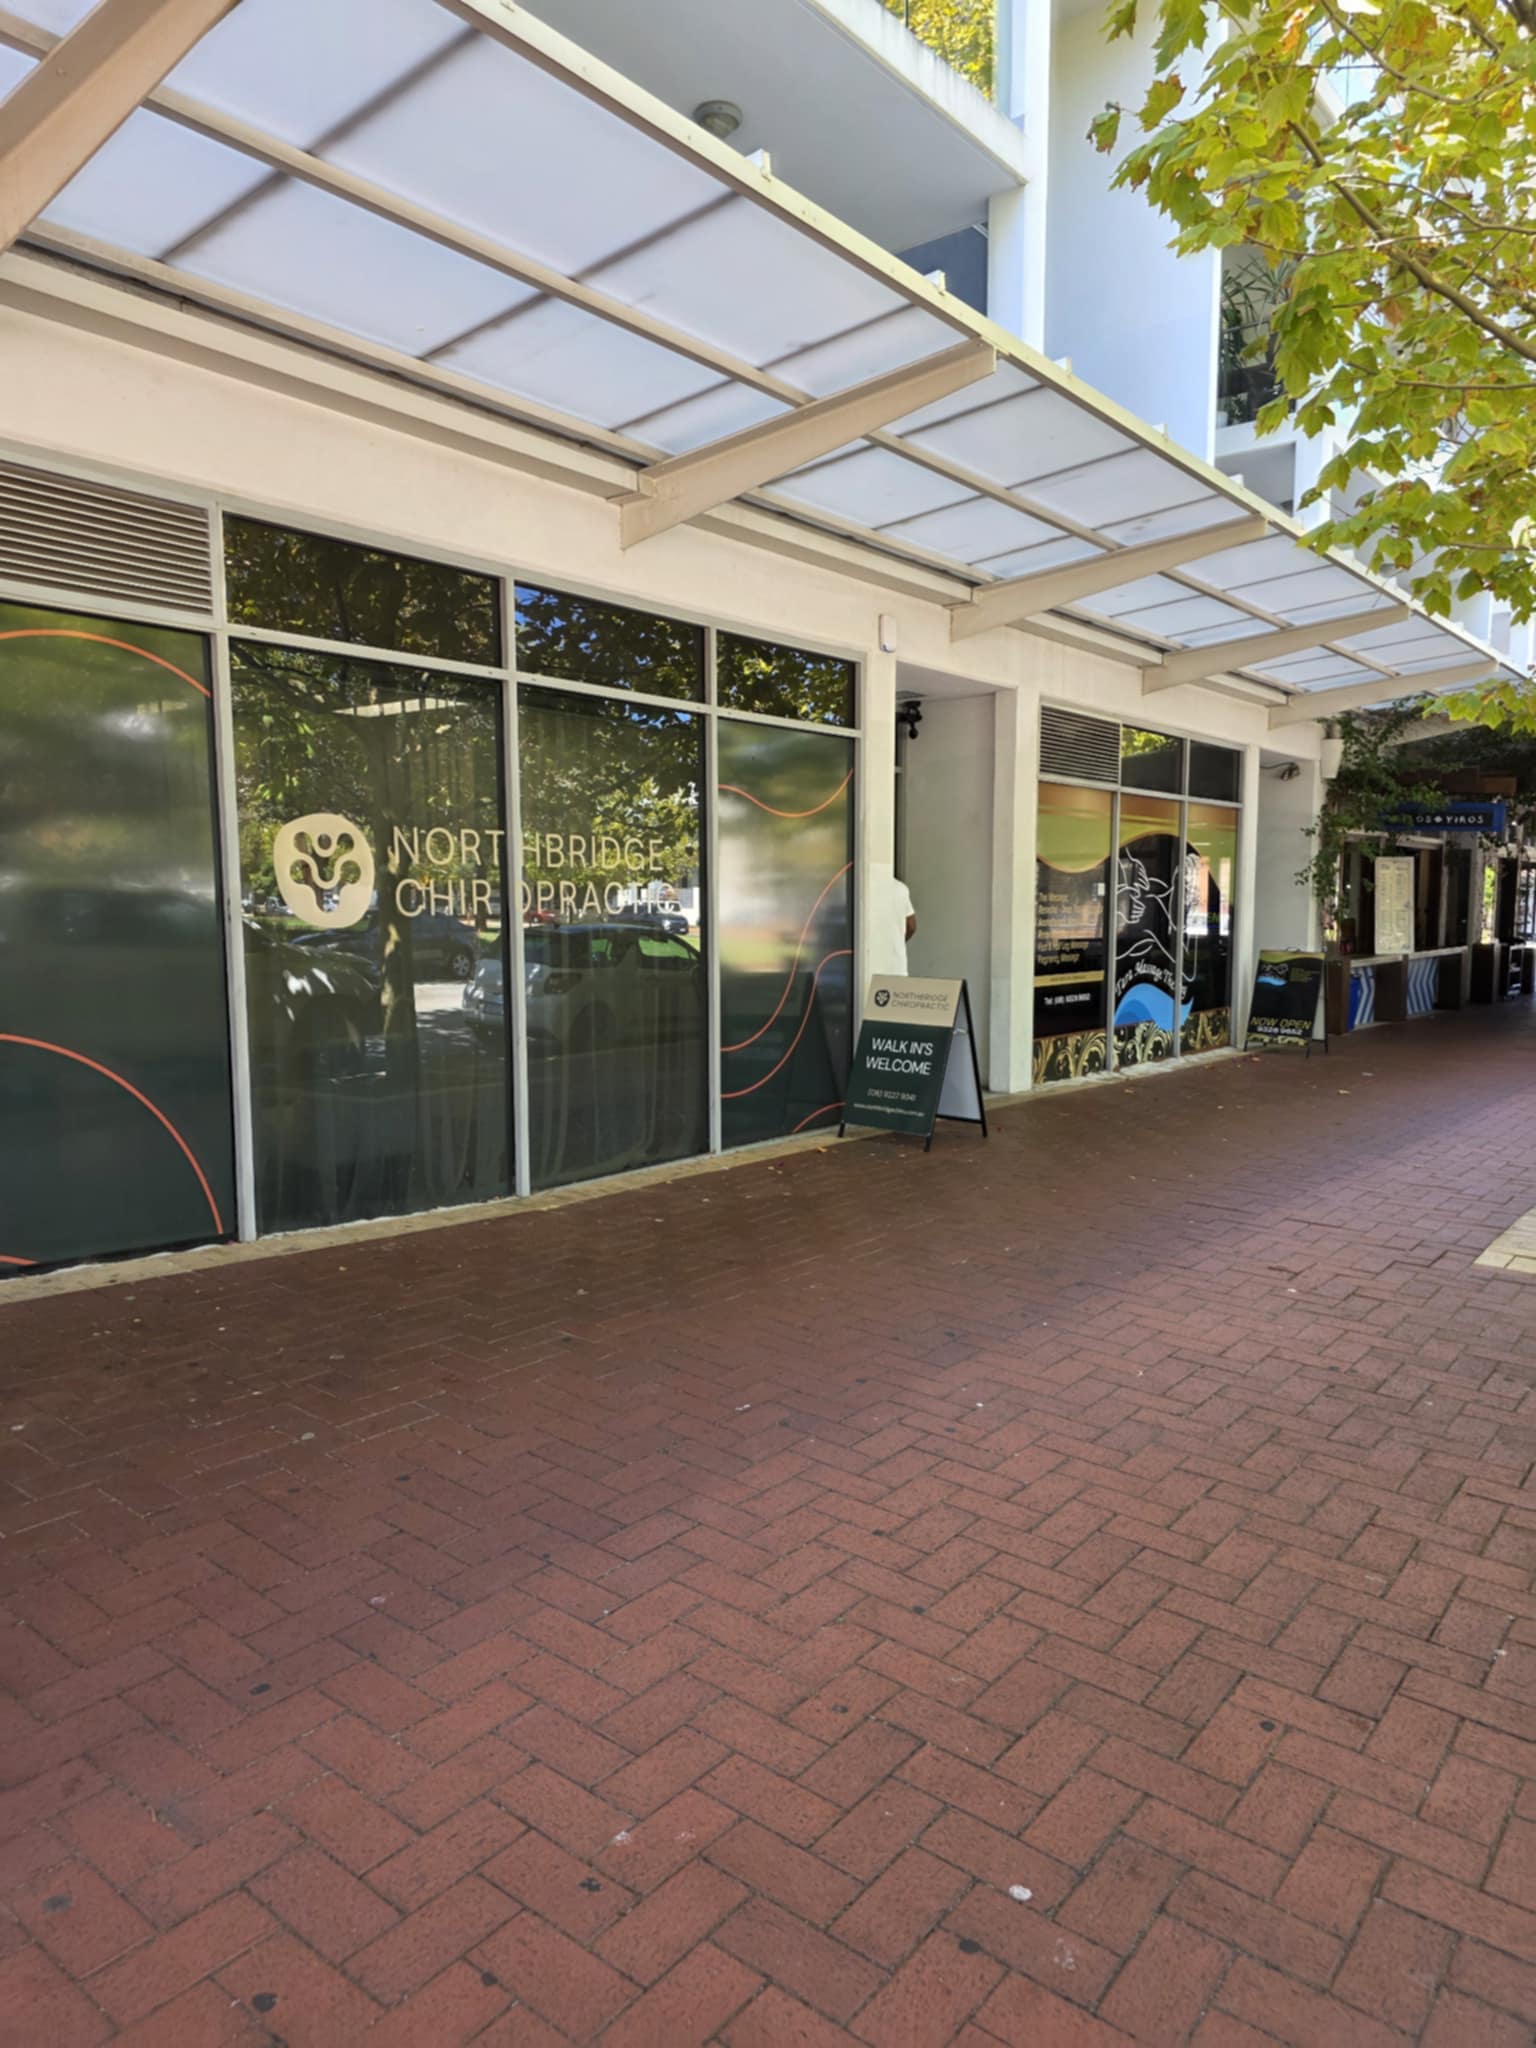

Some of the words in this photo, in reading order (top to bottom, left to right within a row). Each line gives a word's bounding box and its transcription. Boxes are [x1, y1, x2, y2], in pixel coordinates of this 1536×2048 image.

[391, 826, 664, 871] NORTHBRIDGE
[395, 878, 675, 917] CHIROPRACTIC
[891, 1000, 949, 1010] CHIROPRACTIC
[892, 991, 948, 1001] NORTHBRIDGE
[1251, 1016, 1278, 1026] NOW
[1280, 1018, 1312, 1030] OPEN
[872, 1036, 908, 1054] WALK
[911, 1041, 933, 1056] IN'S
[866, 1055, 932, 1075] WELCOME
